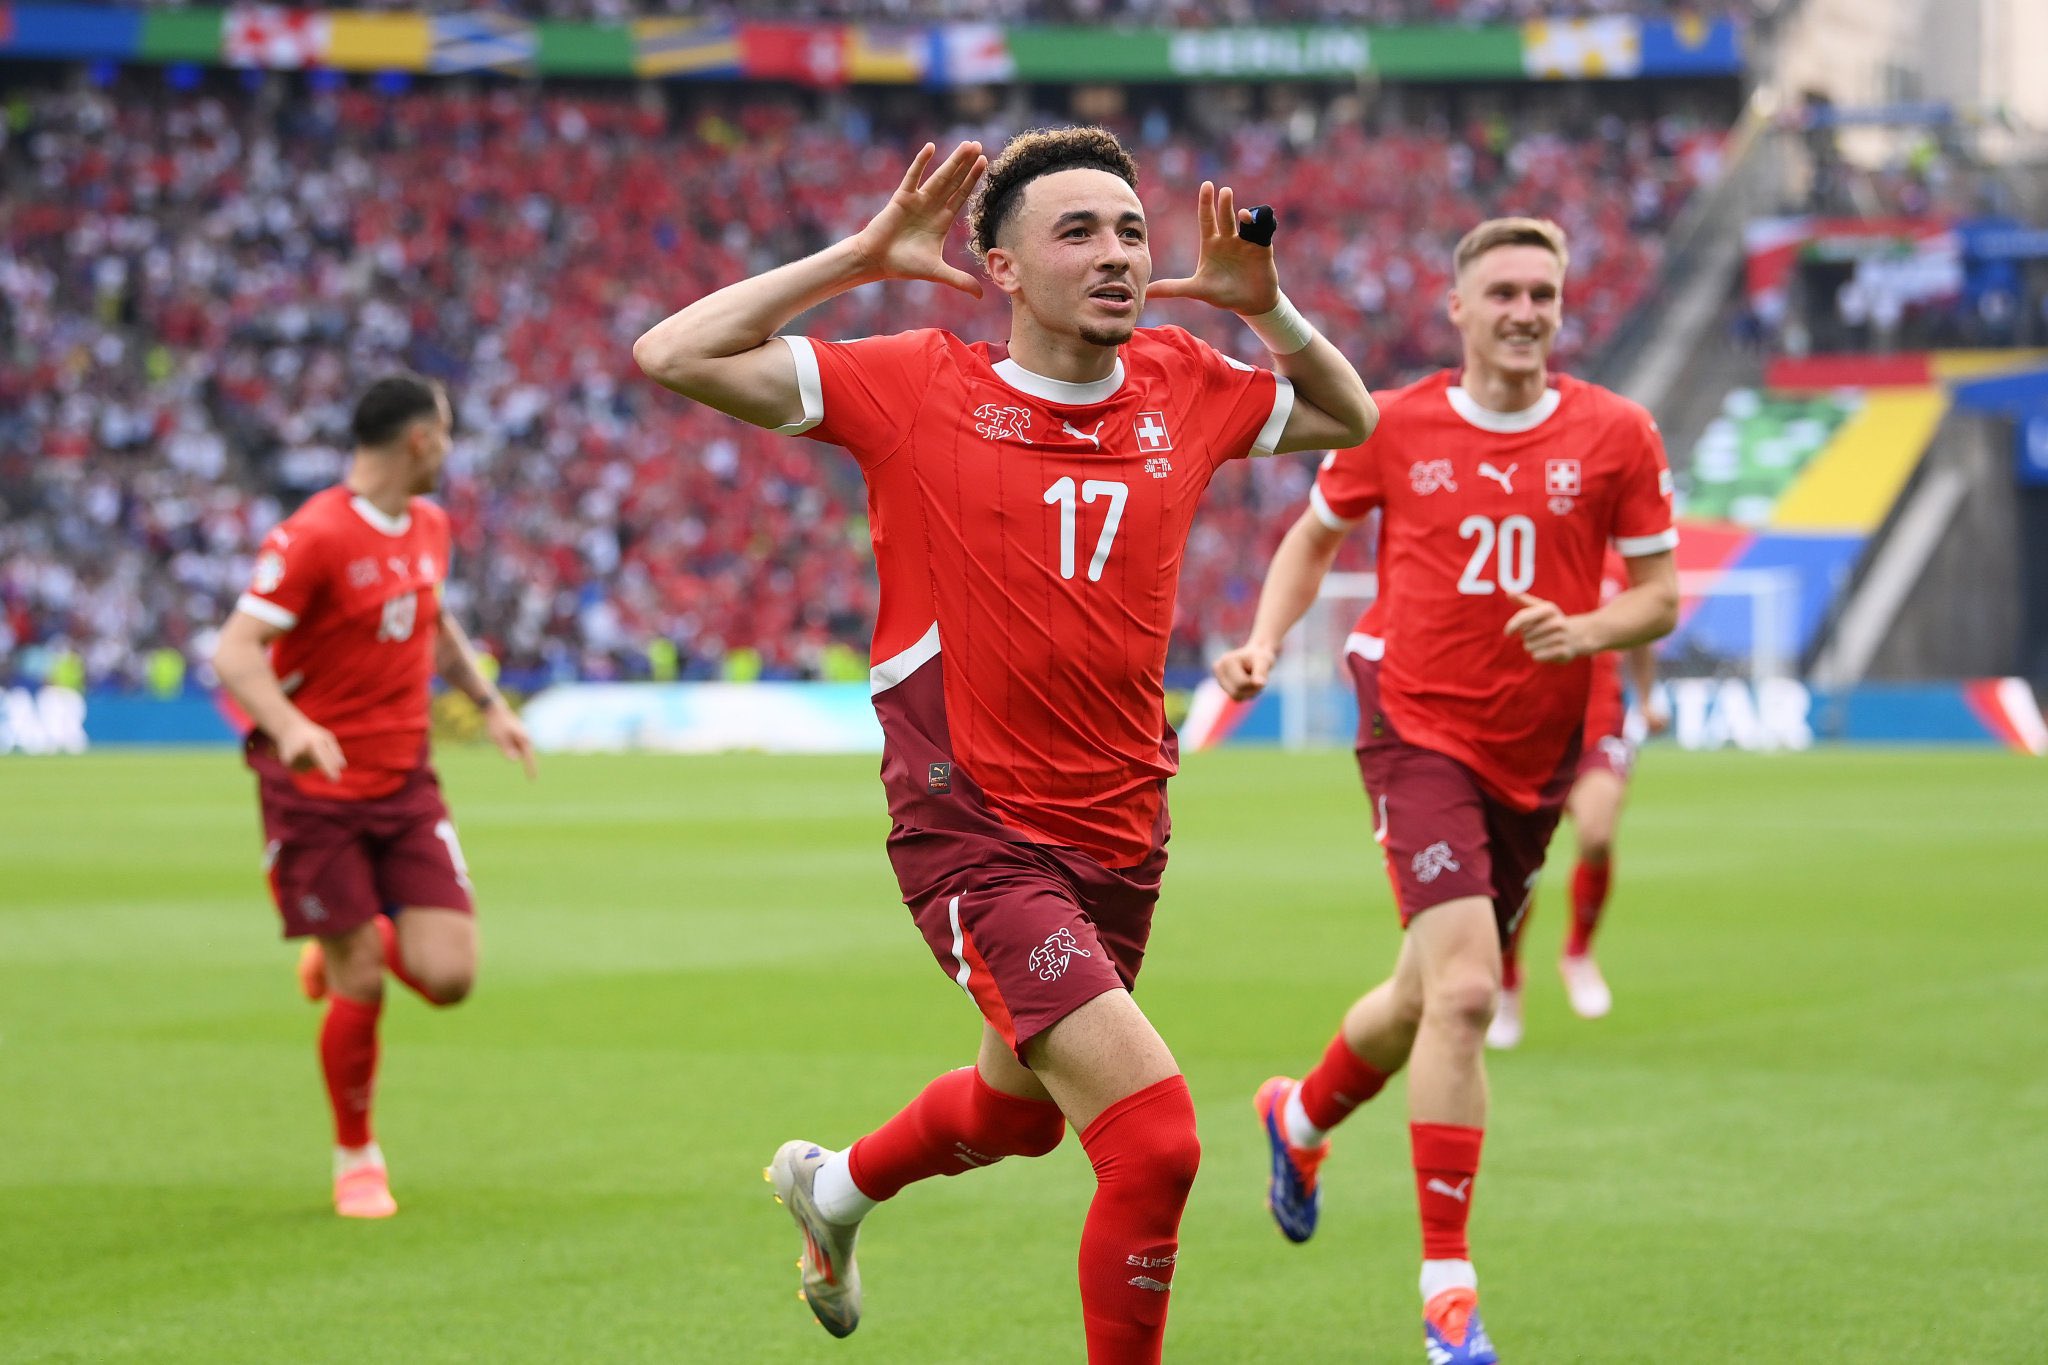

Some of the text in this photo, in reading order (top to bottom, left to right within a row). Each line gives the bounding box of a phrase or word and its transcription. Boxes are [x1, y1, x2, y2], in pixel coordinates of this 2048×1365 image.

[1169, 29, 1368, 77] BERLIN
[1144, 464, 1156, 473] SUI
[1162, 463, 1172, 472] ITA
[1043, 476, 1129, 582] 17
[1456, 514, 1536, 596] 20
